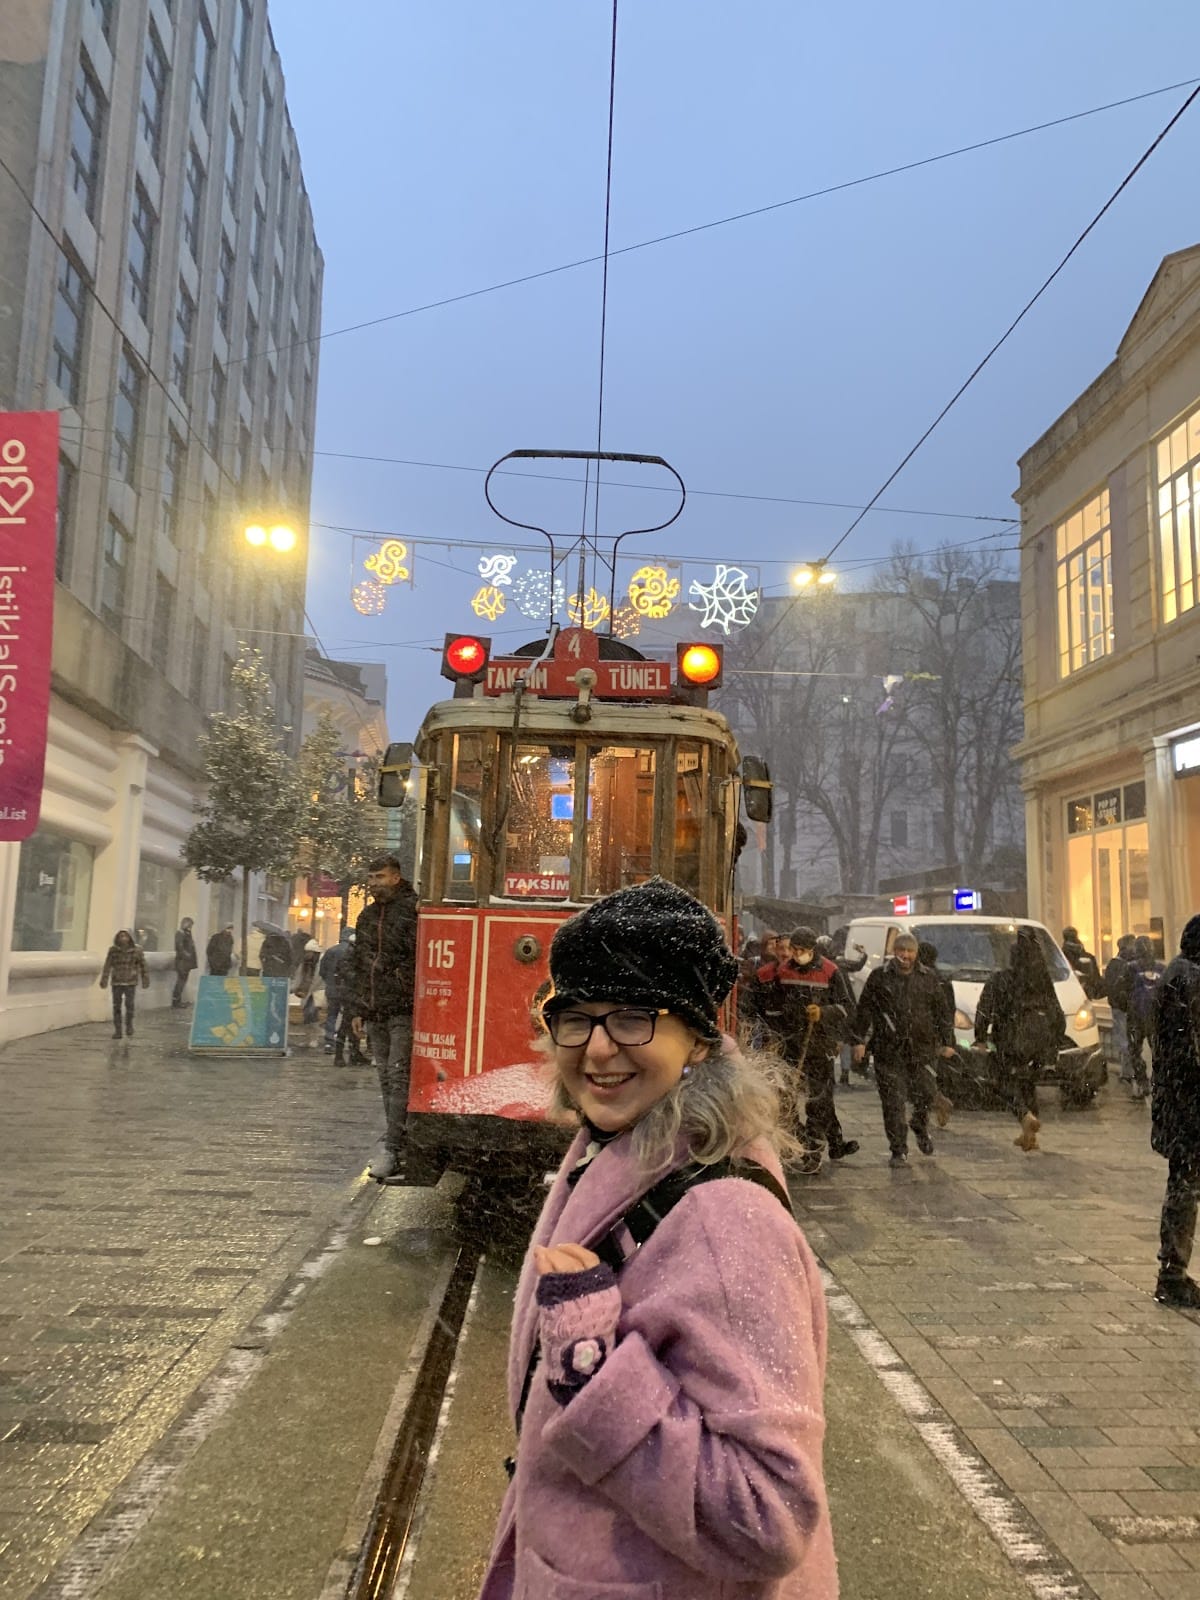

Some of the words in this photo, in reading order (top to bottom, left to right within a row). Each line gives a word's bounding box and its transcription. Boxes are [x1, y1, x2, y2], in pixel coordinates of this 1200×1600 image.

[567, 632, 581, 659] 4
[609, 667, 667, 690] TÜNEL
[507, 876, 570, 890] TAKSİM
[428, 939, 455, 969] 115
